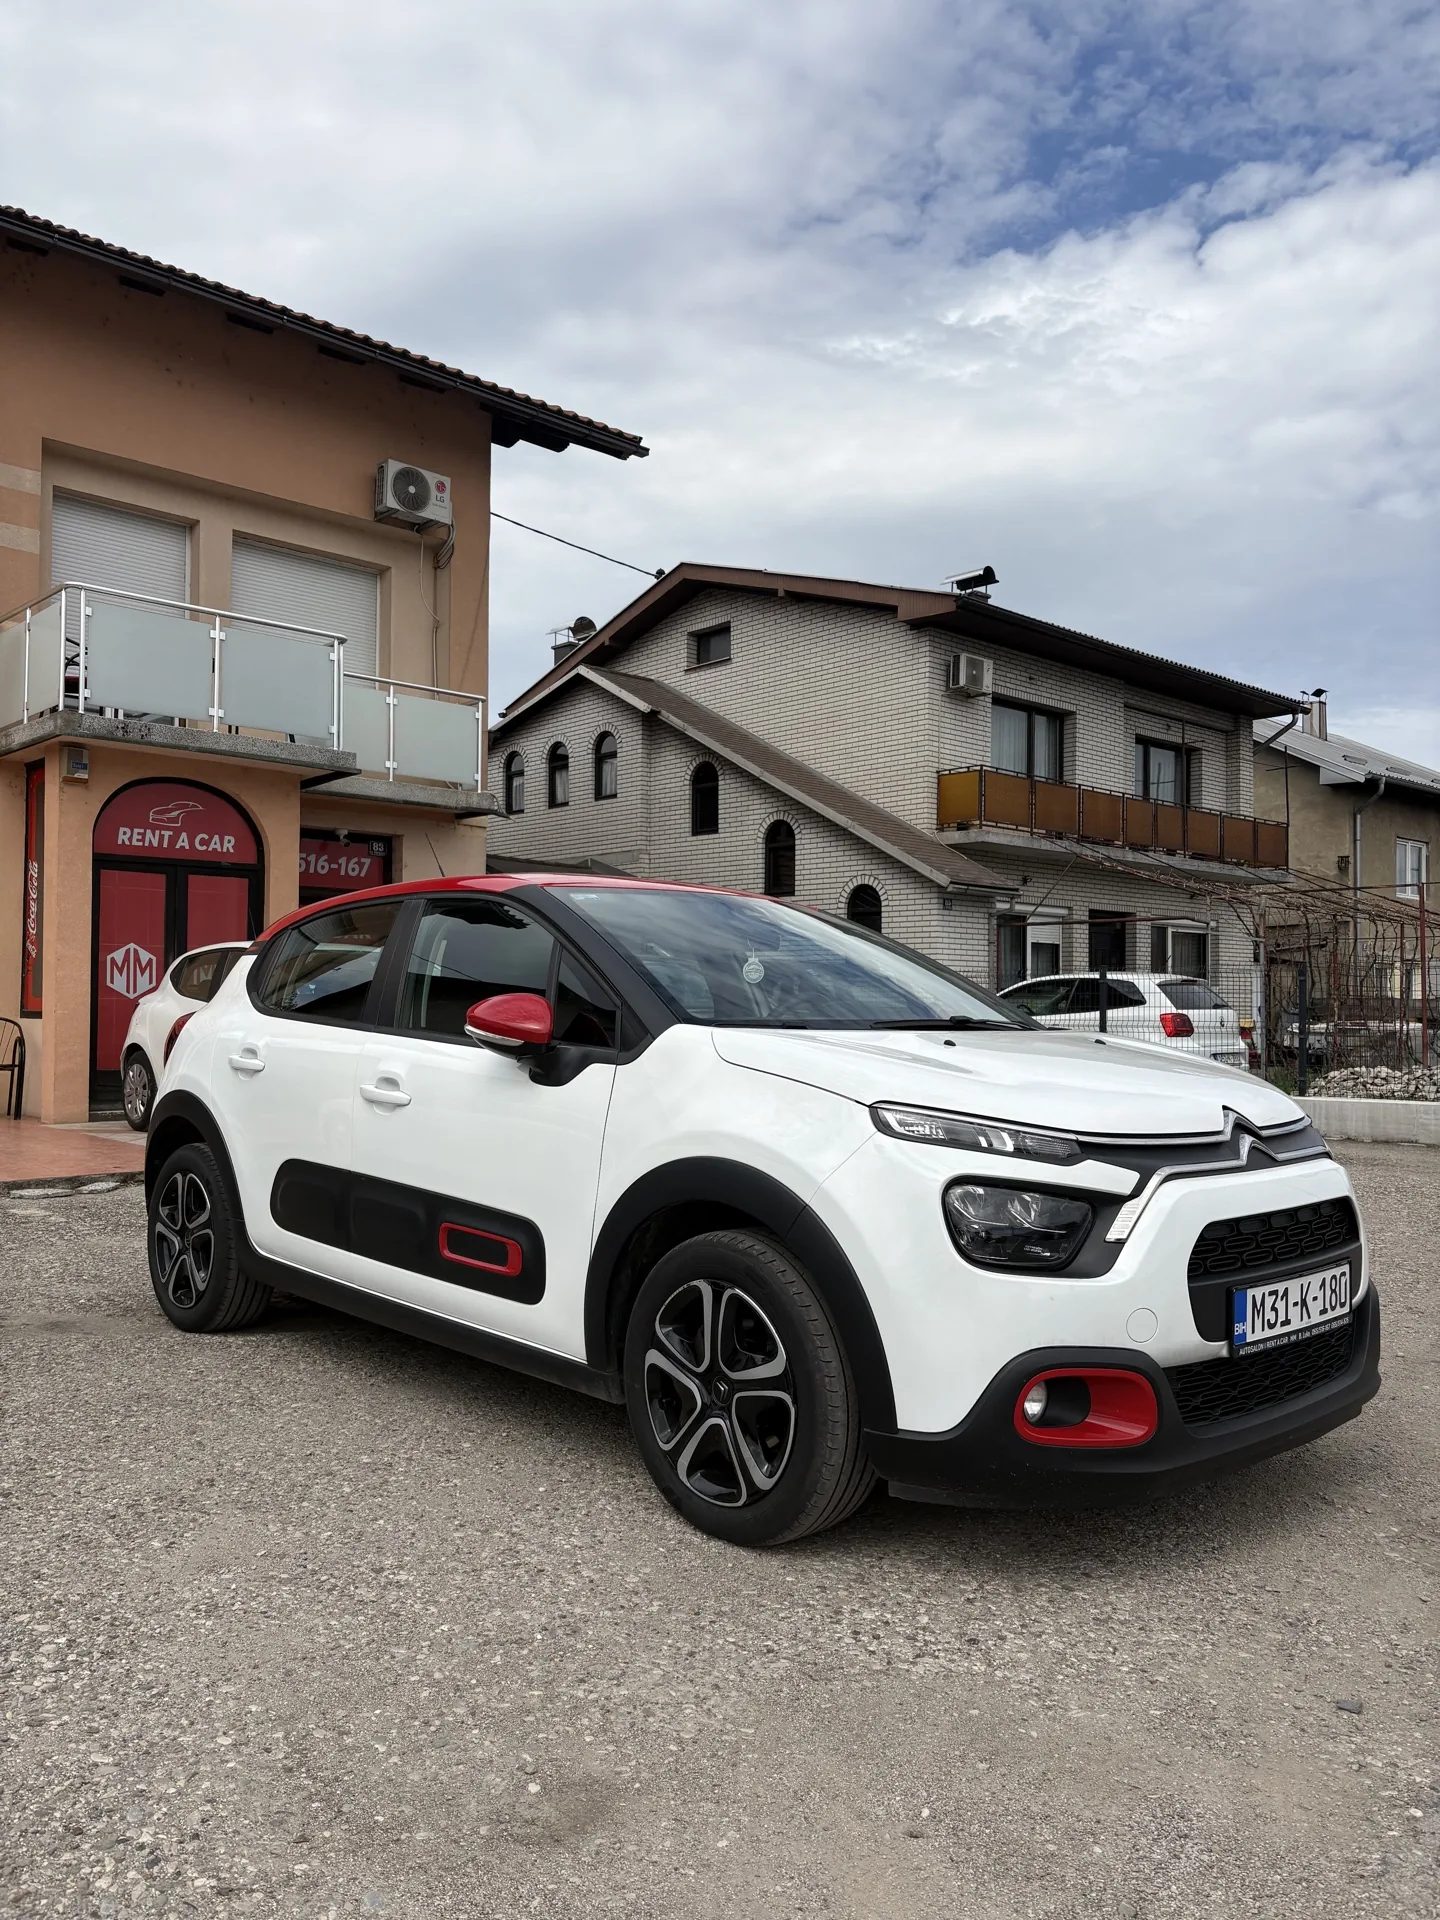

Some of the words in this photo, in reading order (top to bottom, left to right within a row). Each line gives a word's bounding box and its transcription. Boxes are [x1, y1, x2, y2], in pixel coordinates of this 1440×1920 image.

[436, 494, 445, 503] LG
[117, 827, 173, 848] RENT
[175, 832, 190, 850] A
[194, 833, 236, 853] CAR
[372, 842, 384, 852] 83
[299, 852, 371, 877] 516-167
[1251, 1271, 1347, 1335] M31-K-180
[1234, 1322, 1247, 1335] BIH
[1267, 1339, 1277, 1349] RENT
[1280, 1336, 1289, 1345] CAR
